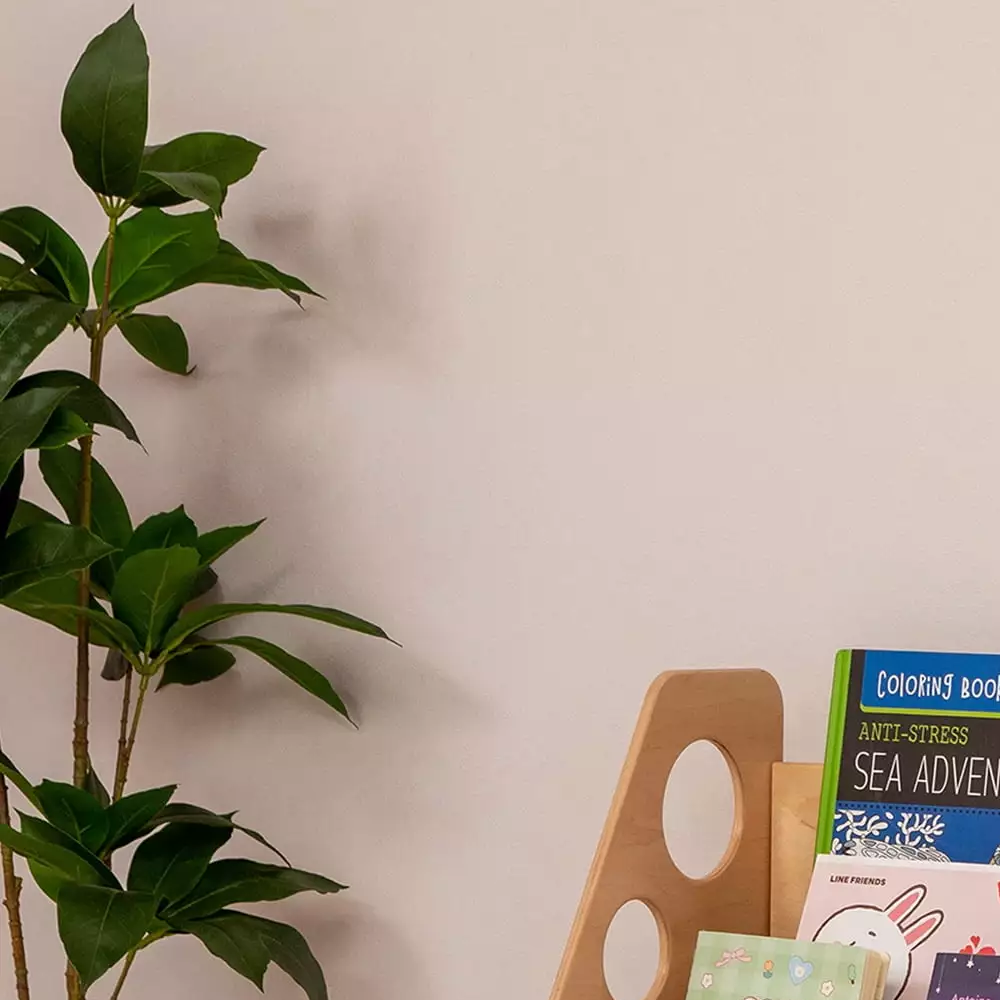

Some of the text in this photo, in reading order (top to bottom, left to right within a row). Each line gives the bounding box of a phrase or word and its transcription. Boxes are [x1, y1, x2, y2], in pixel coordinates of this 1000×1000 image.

[858, 721, 969, 746] ANTI-STRESS
[854, 751, 902, 793] SEA
[830, 875, 886, 886] LINE FRIENDS
